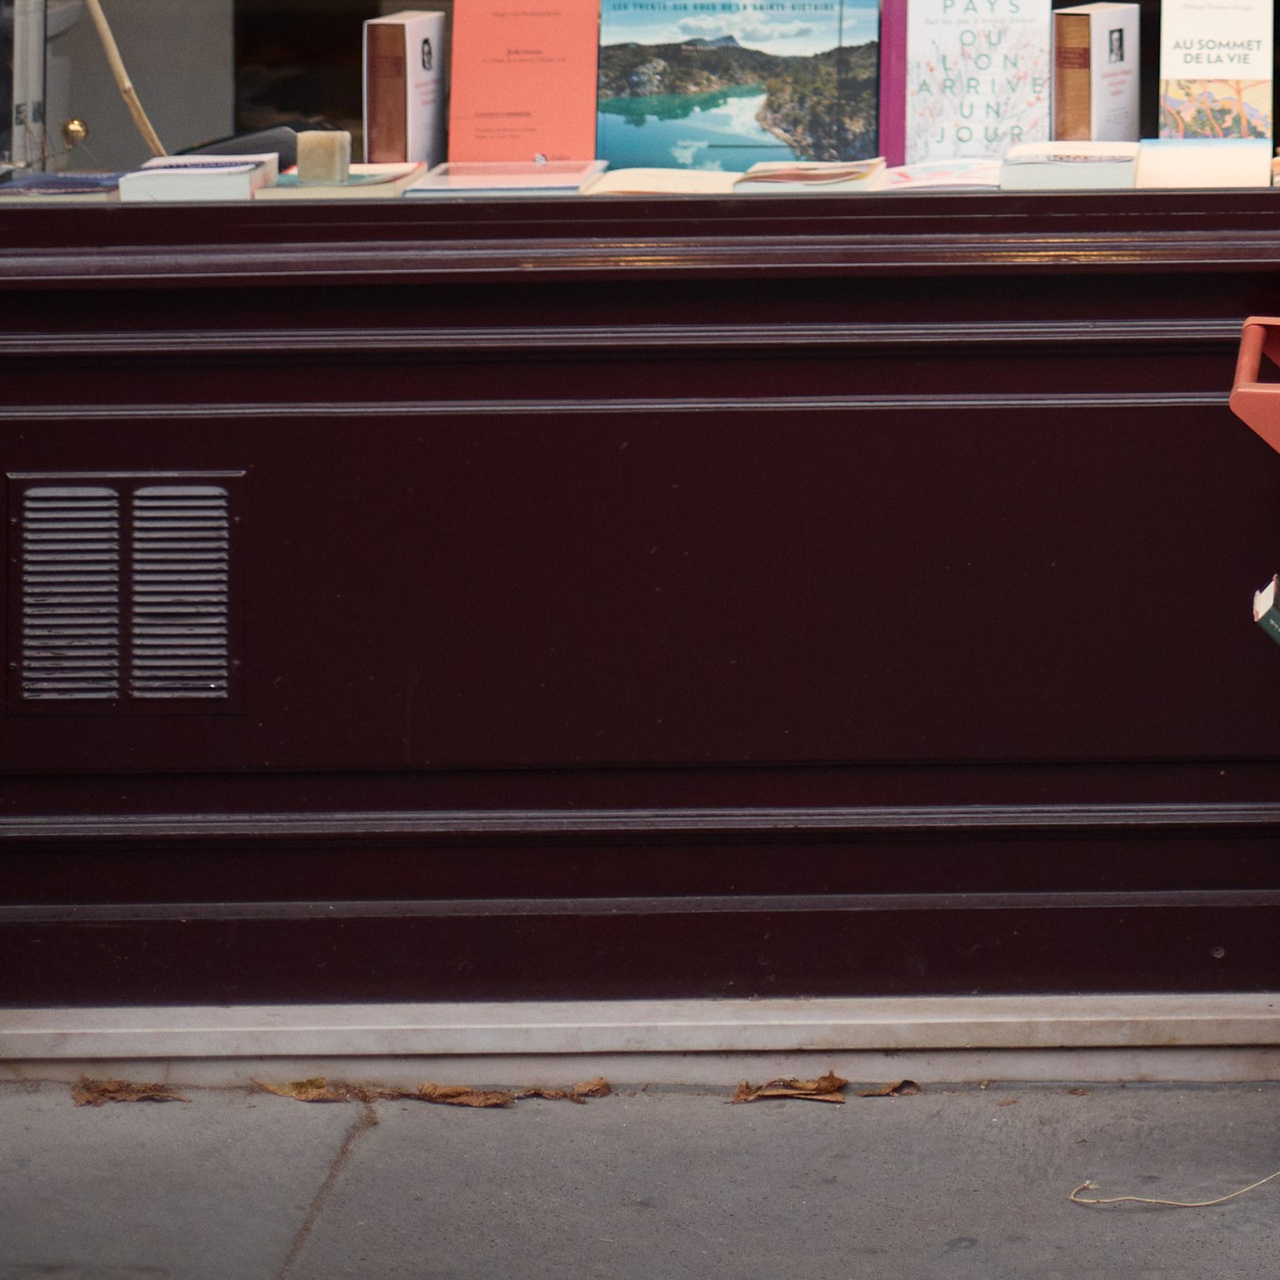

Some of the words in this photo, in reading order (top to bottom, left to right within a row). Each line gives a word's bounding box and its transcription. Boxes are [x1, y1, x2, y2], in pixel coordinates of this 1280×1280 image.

[1173, 39, 1194, 51] AU
[1198, 38, 1262, 51] SOMMET
[1183, 53, 1202, 65] DE
[1207, 53, 1224, 65] LA
[1227, 53, 1251, 65] VIE
[917, 76, 1045, 95] ARRIVE
[959, 101, 1001, 120] UN
[936, 125, 1024, 144] JOUR
